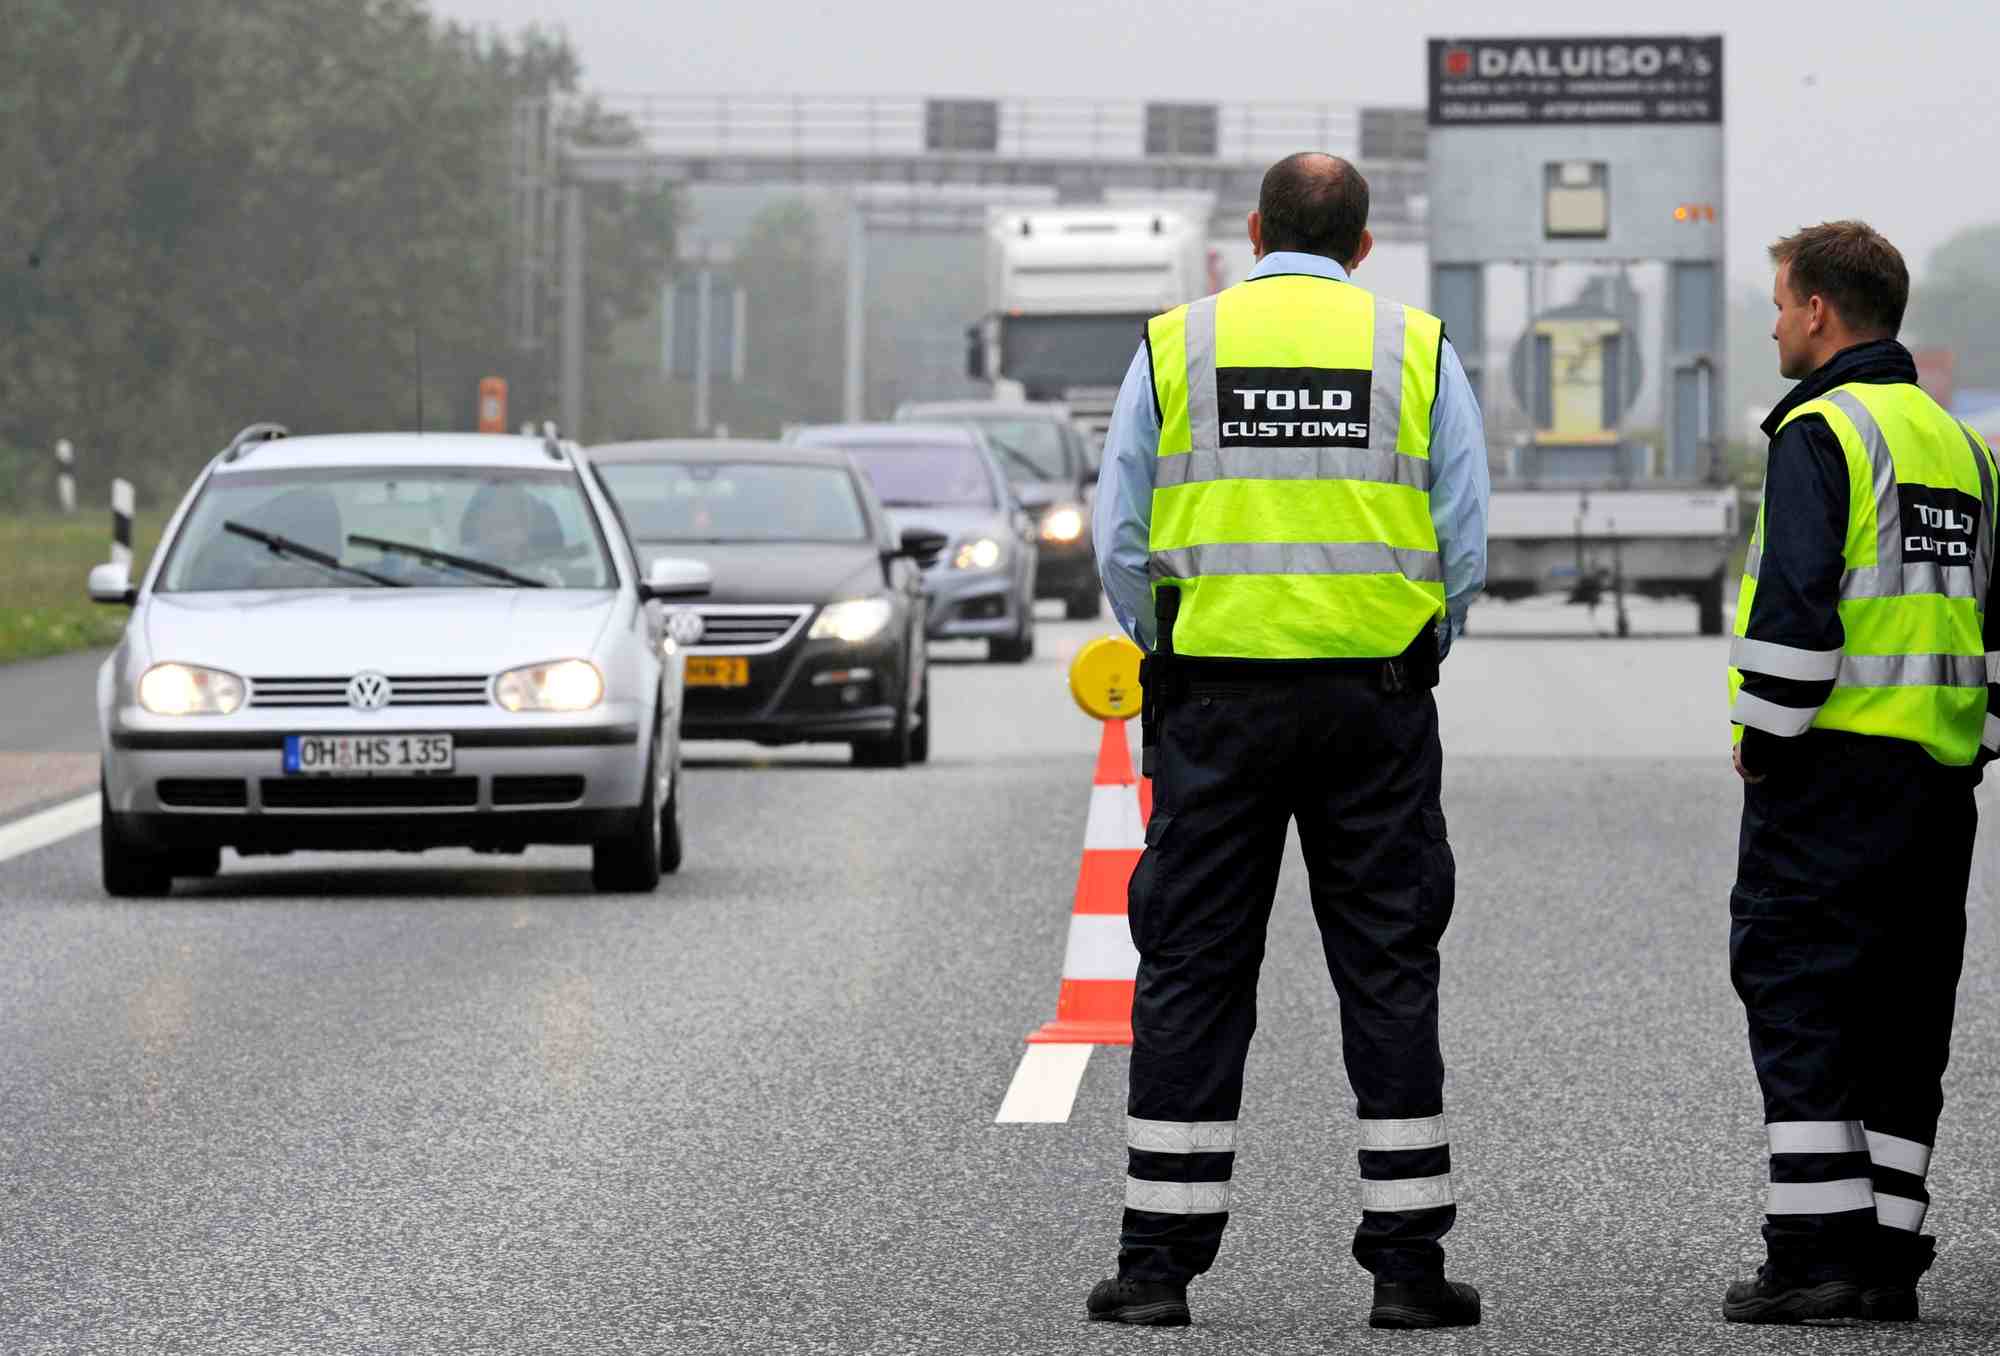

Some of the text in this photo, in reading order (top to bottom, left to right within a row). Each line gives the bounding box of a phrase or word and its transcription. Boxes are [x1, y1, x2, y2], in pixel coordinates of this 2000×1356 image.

[1478, 46, 1662, 77] DALUISO
[1233, 389, 1352, 410] TOLD
[1222, 421, 1368, 438] CUSTOMS
[302, 739, 448, 765] OH HS 135
